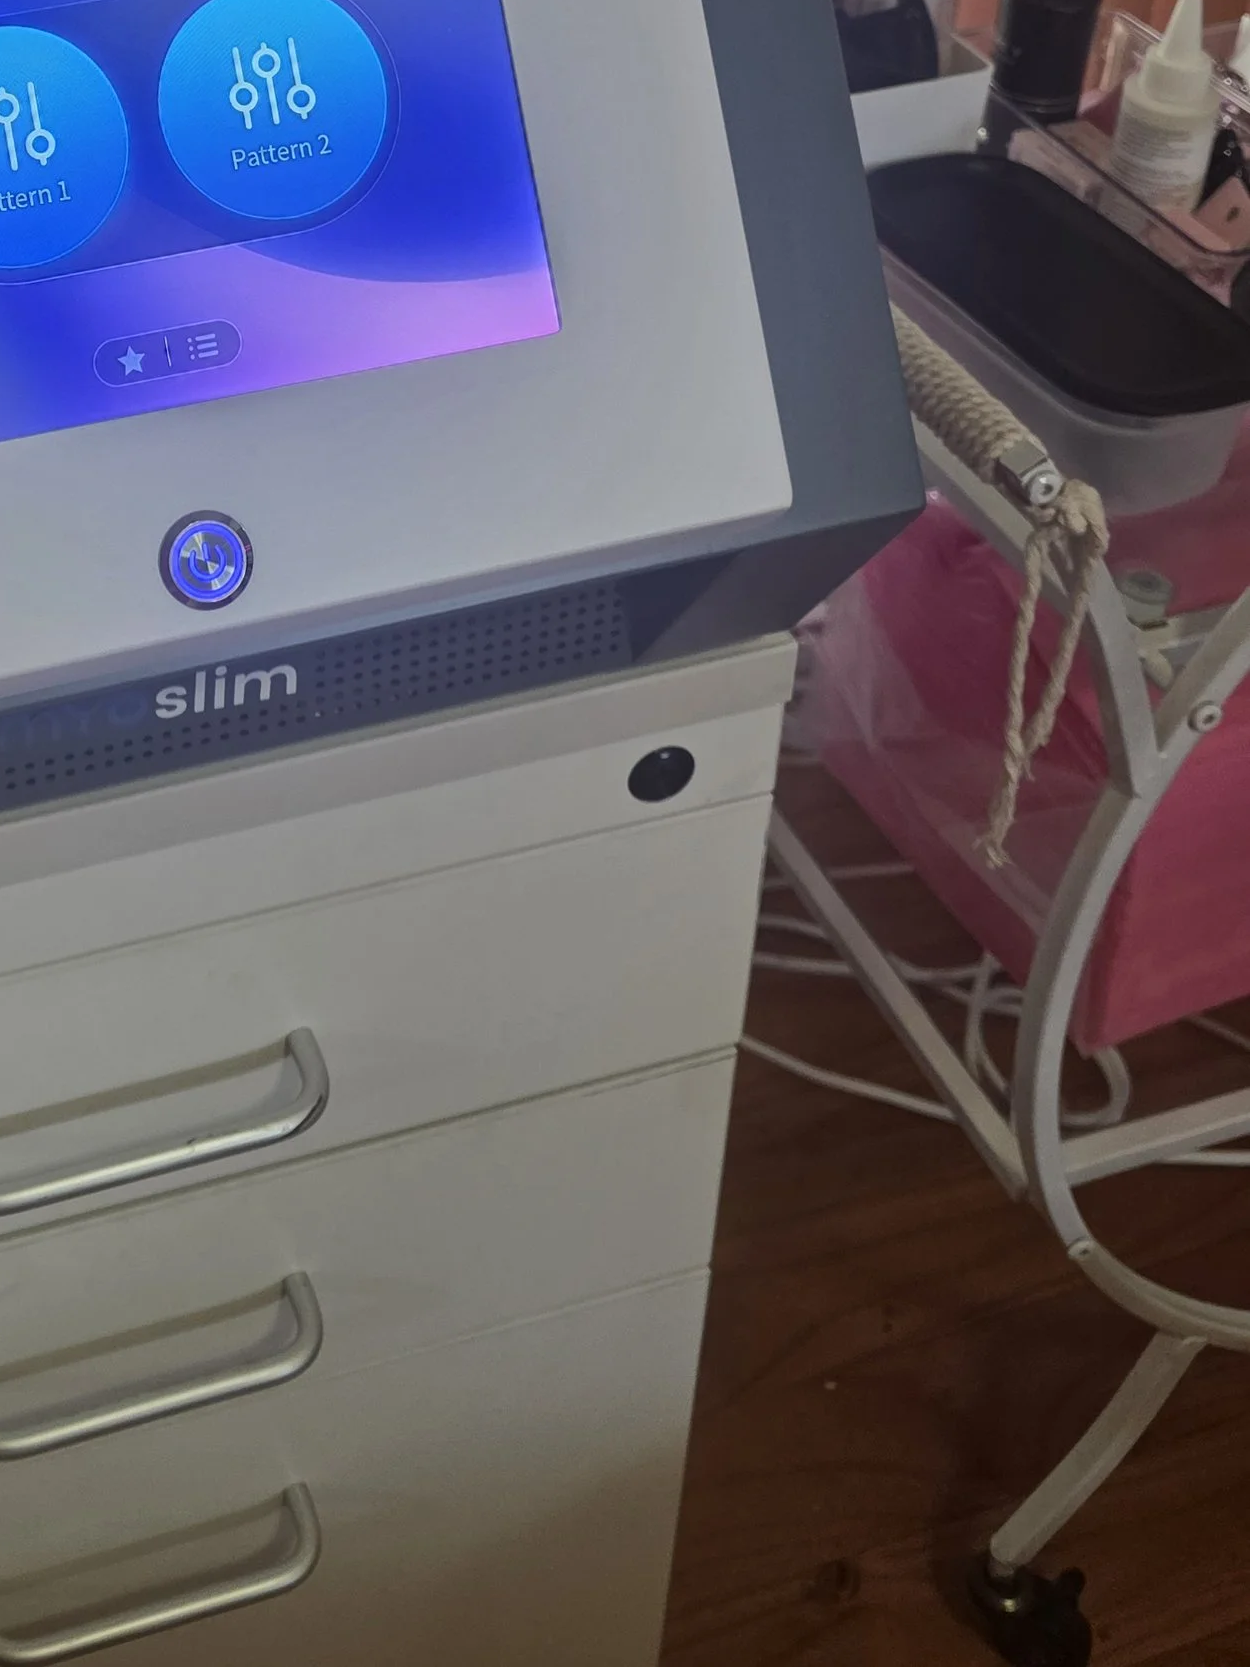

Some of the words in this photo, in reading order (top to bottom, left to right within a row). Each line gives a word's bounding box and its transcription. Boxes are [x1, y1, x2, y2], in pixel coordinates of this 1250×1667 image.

[230, 140, 313, 171] Pattern
[316, 133, 332, 155] 2
[56, 180, 72, 202] 1
